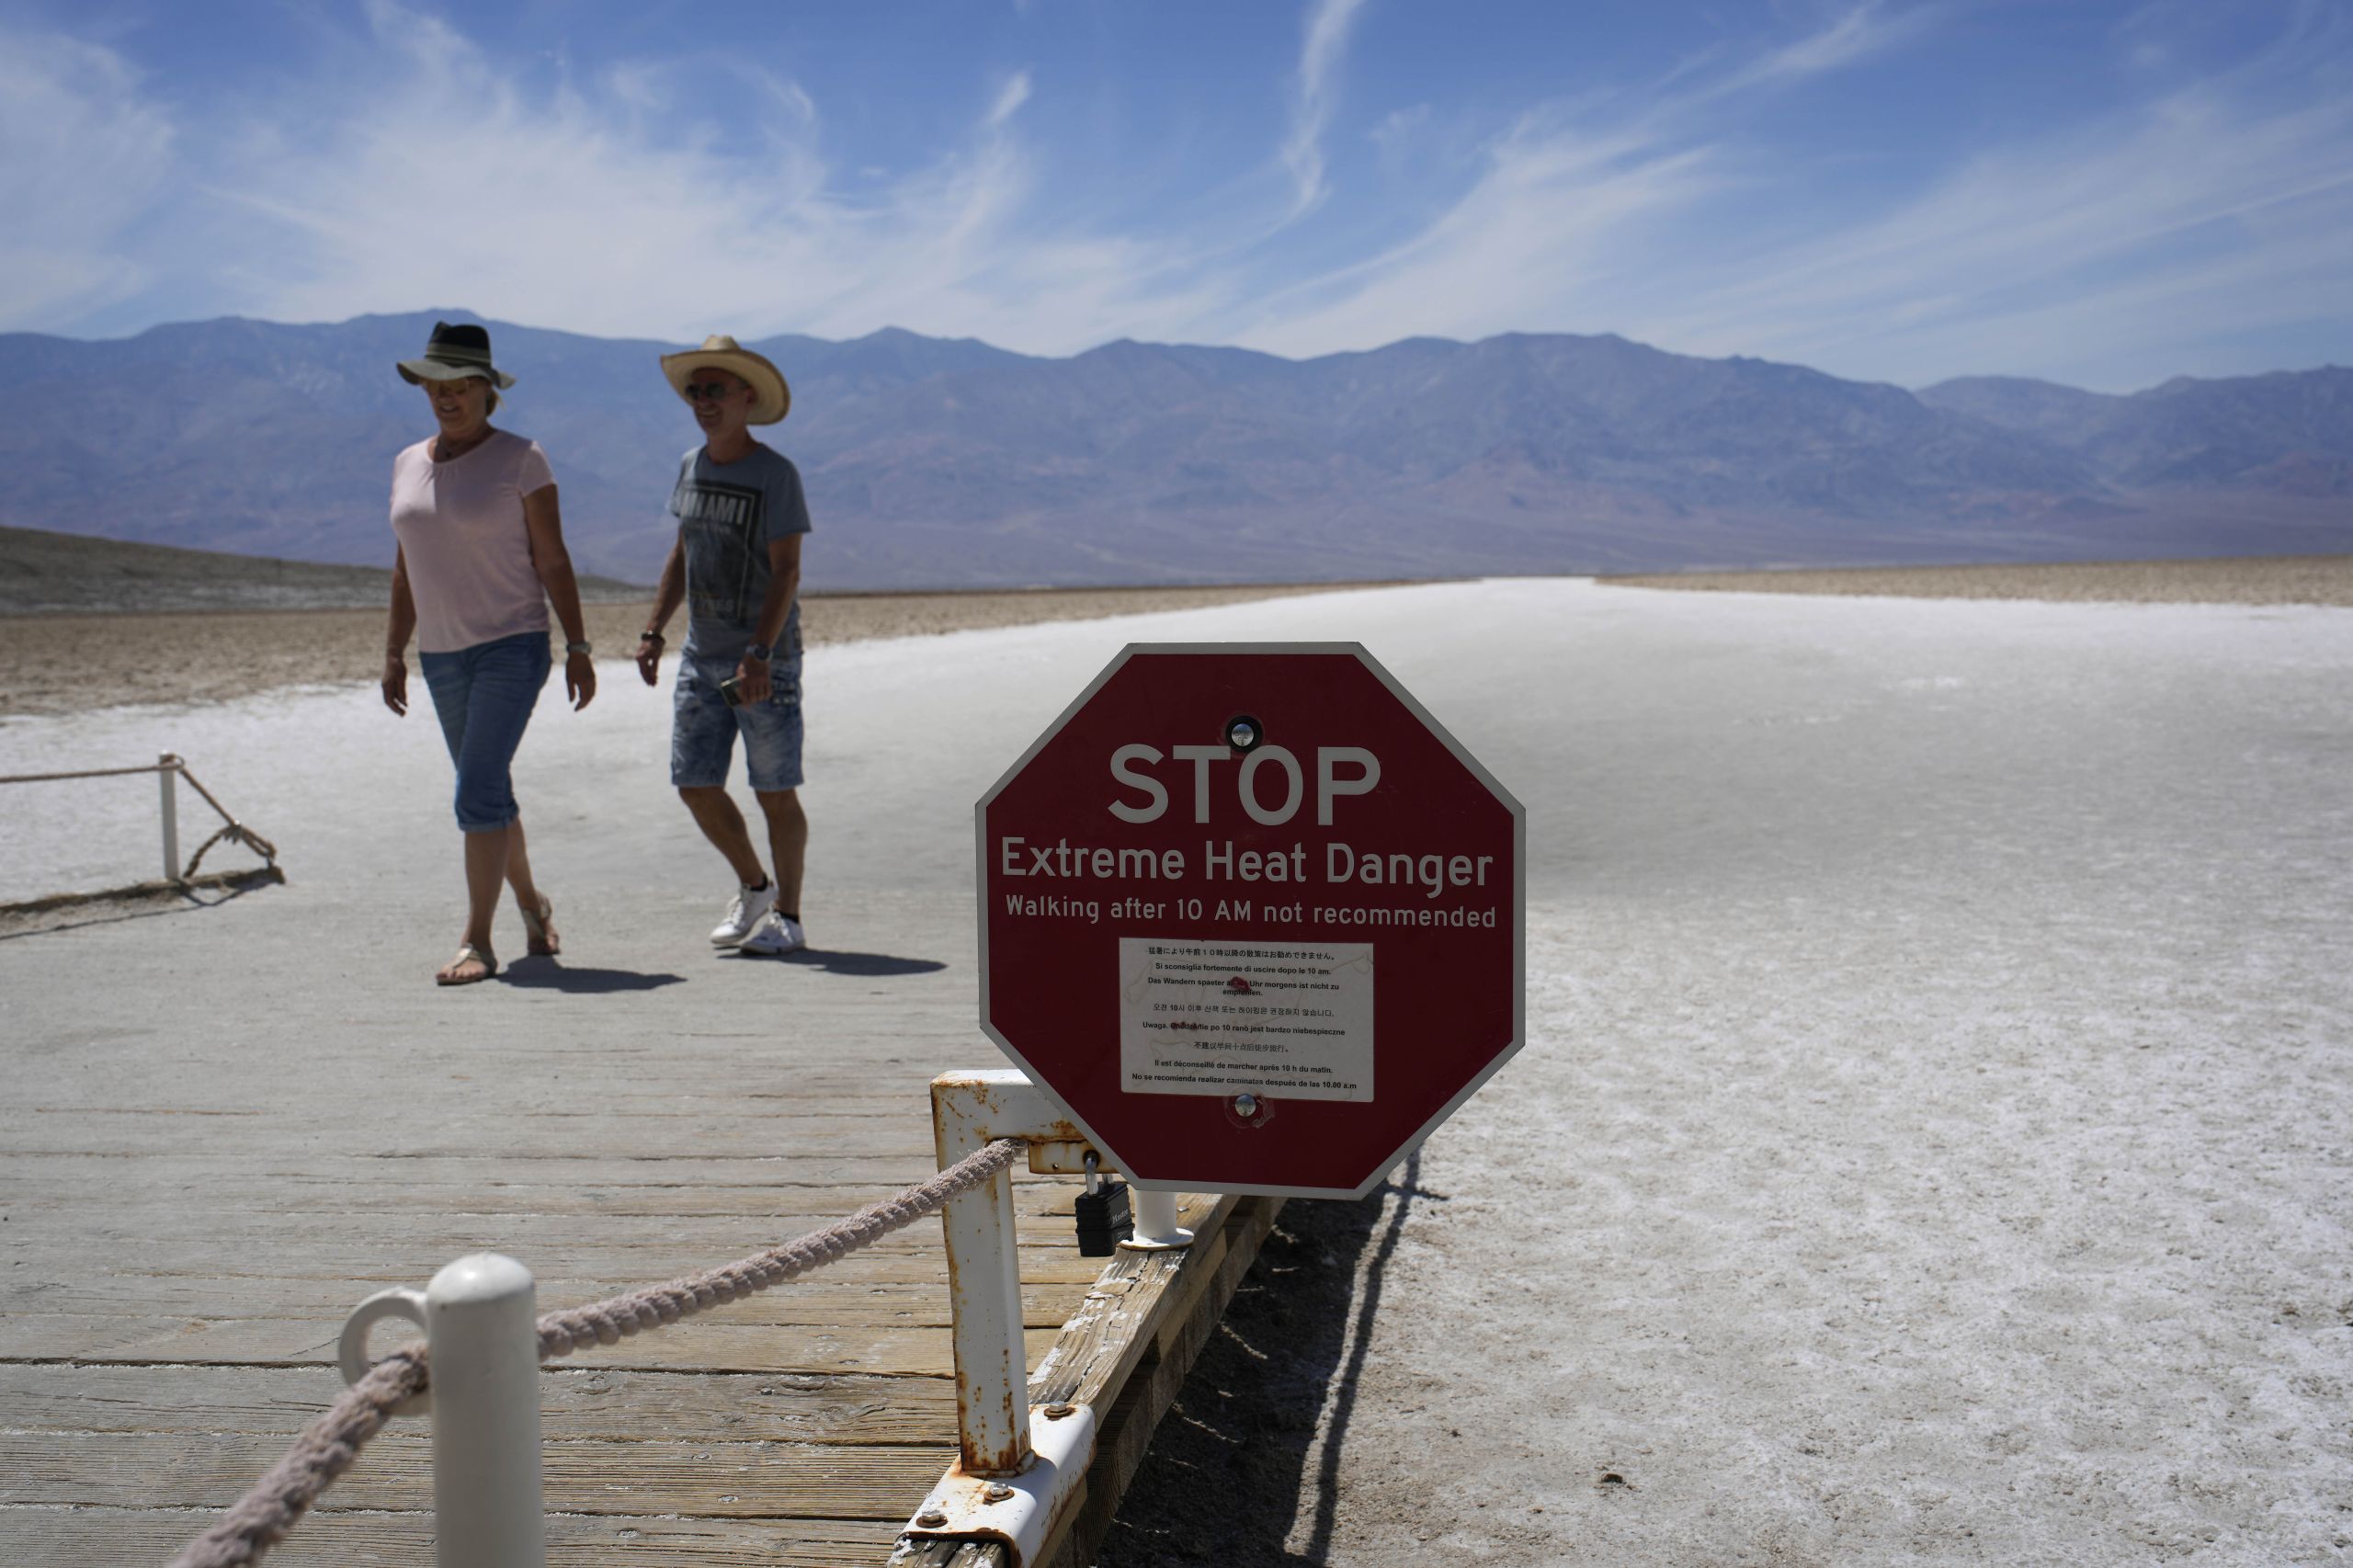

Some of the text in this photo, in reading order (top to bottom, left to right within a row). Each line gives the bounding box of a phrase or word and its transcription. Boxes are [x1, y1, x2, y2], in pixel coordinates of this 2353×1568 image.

[1108, 744, 1381, 825] STOP
[1002, 836, 1494, 898] Extreme Heat Danger
[1006, 894, 1495, 928] Walking after 10 AM not recommended
[1164, 963, 1201, 972] sconsiglia
[1203, 964, 1243, 972] fortemente
[1254, 966, 1277, 974] uscire
[1278, 967, 1297, 975] dopo
[1163, 977, 1196, 985] Wandern
[1198, 979, 1224, 988] spaeter
[1265, 982, 1297, 990] morgens
[1154, 1003, 1167, 1011] 오전
[1169, 1004, 1185, 1012] 10시
[1222, 1006, 1235, 1014] 또는
[1142, 1021, 1168, 1029] Uwaga.
[1266, 1026, 1291, 1034] bardzo
[1174, 1060, 1215, 1068] déconseillé
[1154, 1074, 1196, 1082] recomienda
[1266, 1079, 1297, 1087] después
